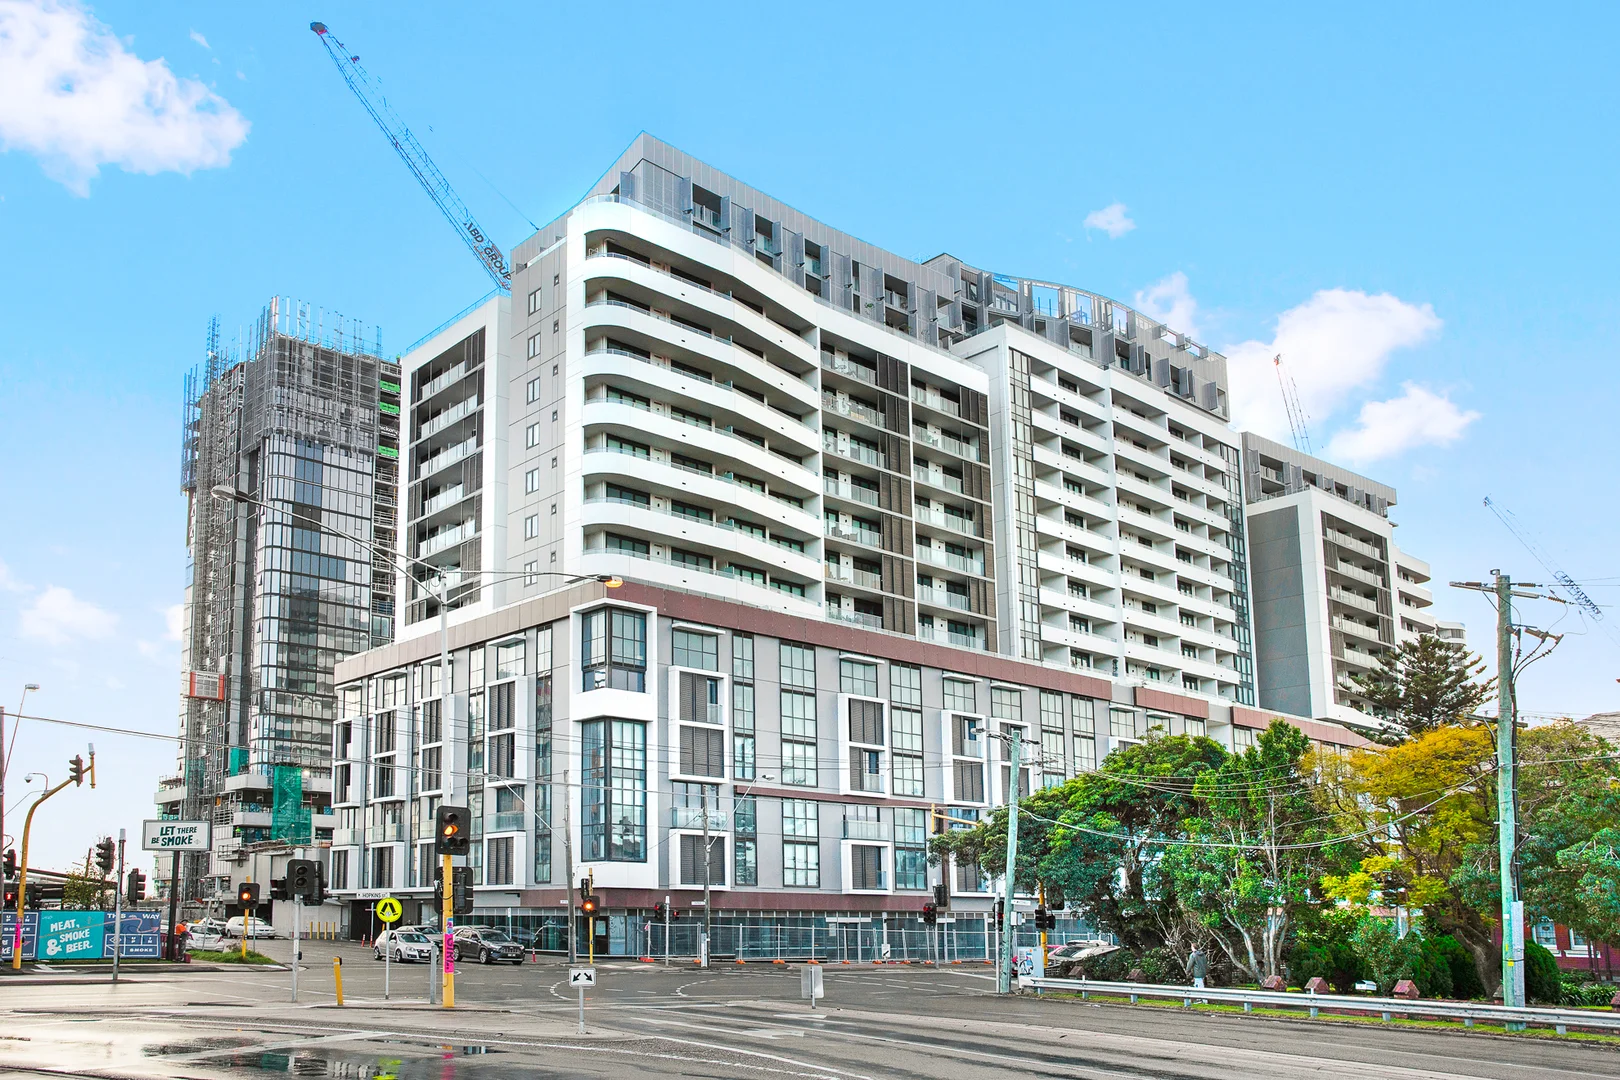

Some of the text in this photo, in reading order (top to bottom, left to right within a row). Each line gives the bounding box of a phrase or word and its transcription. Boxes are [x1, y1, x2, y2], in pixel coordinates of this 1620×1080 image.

[463, 222, 511, 280] ABD GROUP
[160, 826, 197, 836] LET THERE
[161, 835, 193, 847] SMOKE
[50, 919, 80, 932] MEAT,
[59, 928, 90, 943] SMOKE
[46, 938, 93, 956] & BEER.
